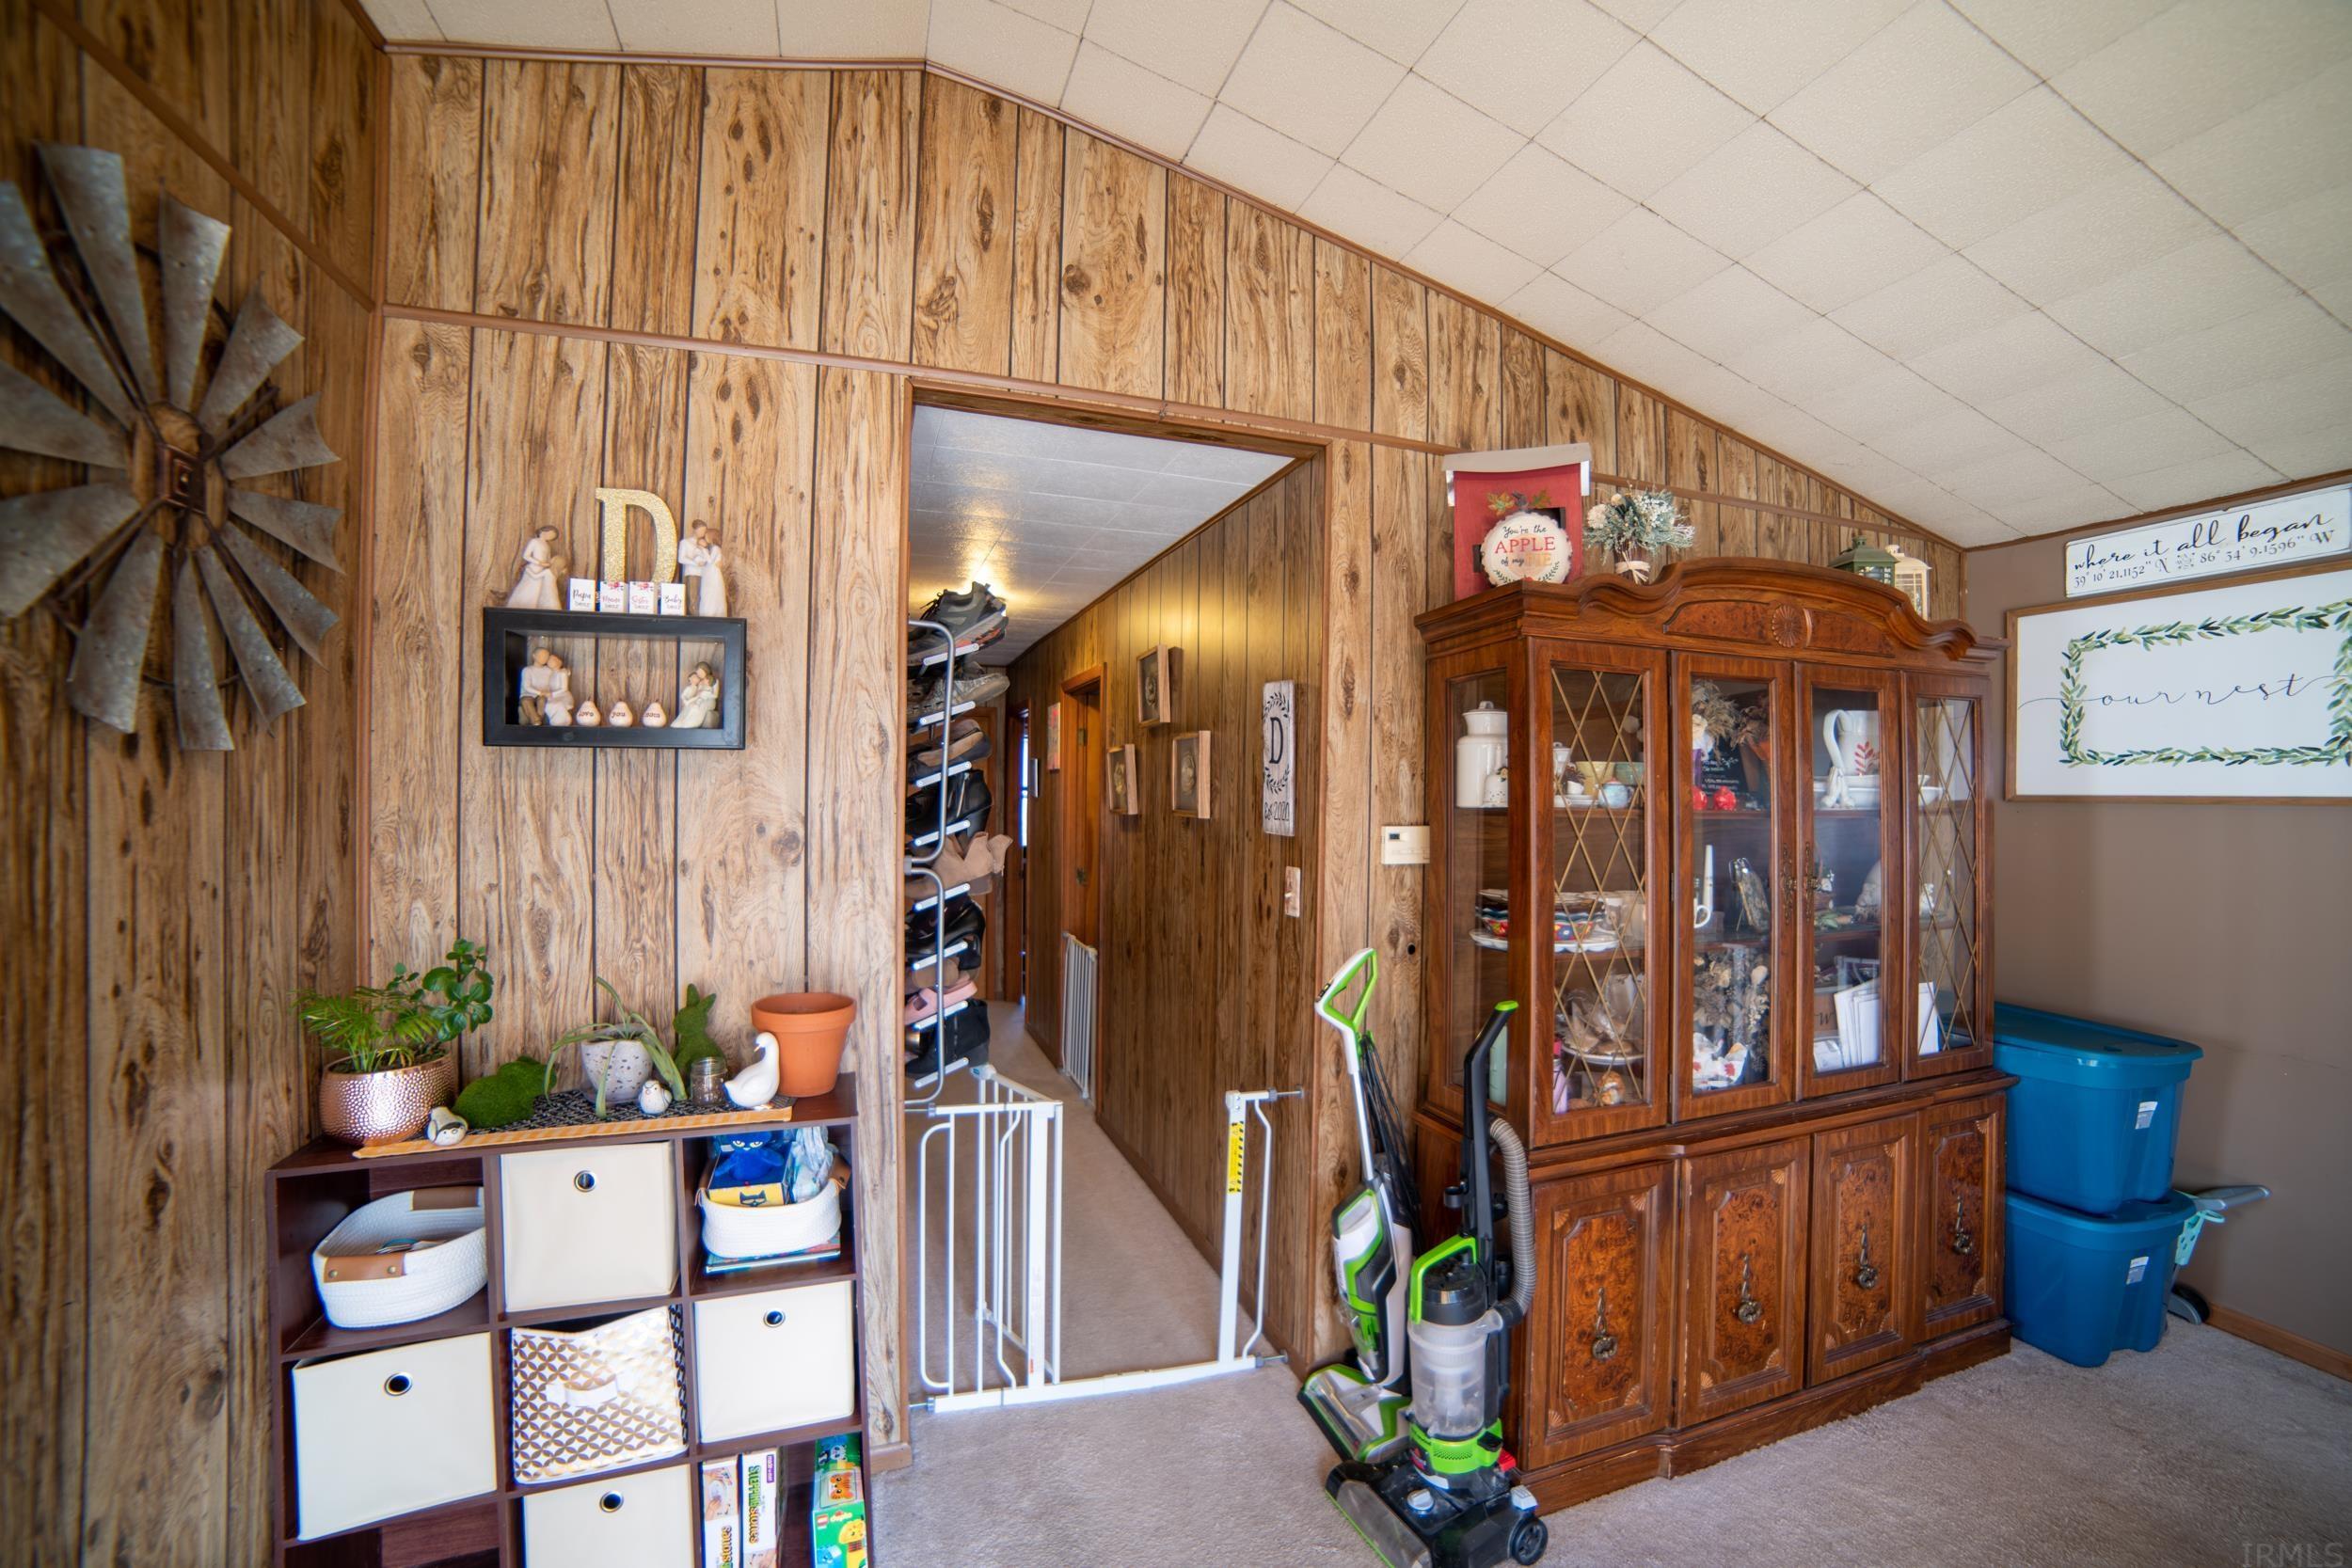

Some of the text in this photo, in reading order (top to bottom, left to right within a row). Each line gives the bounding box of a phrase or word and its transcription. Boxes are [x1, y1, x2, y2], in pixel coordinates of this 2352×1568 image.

[596, 487, 677, 583] D
[1494, 536, 1556, 554] APPLE
[1502, 524, 1547, 538] You're the
[2074, 514, 2334, 571] where it all began
[2196, 673, 2319, 705] nest
[1268, 717, 1283, 764] D
[749, 1506, 759, 1544] stones
